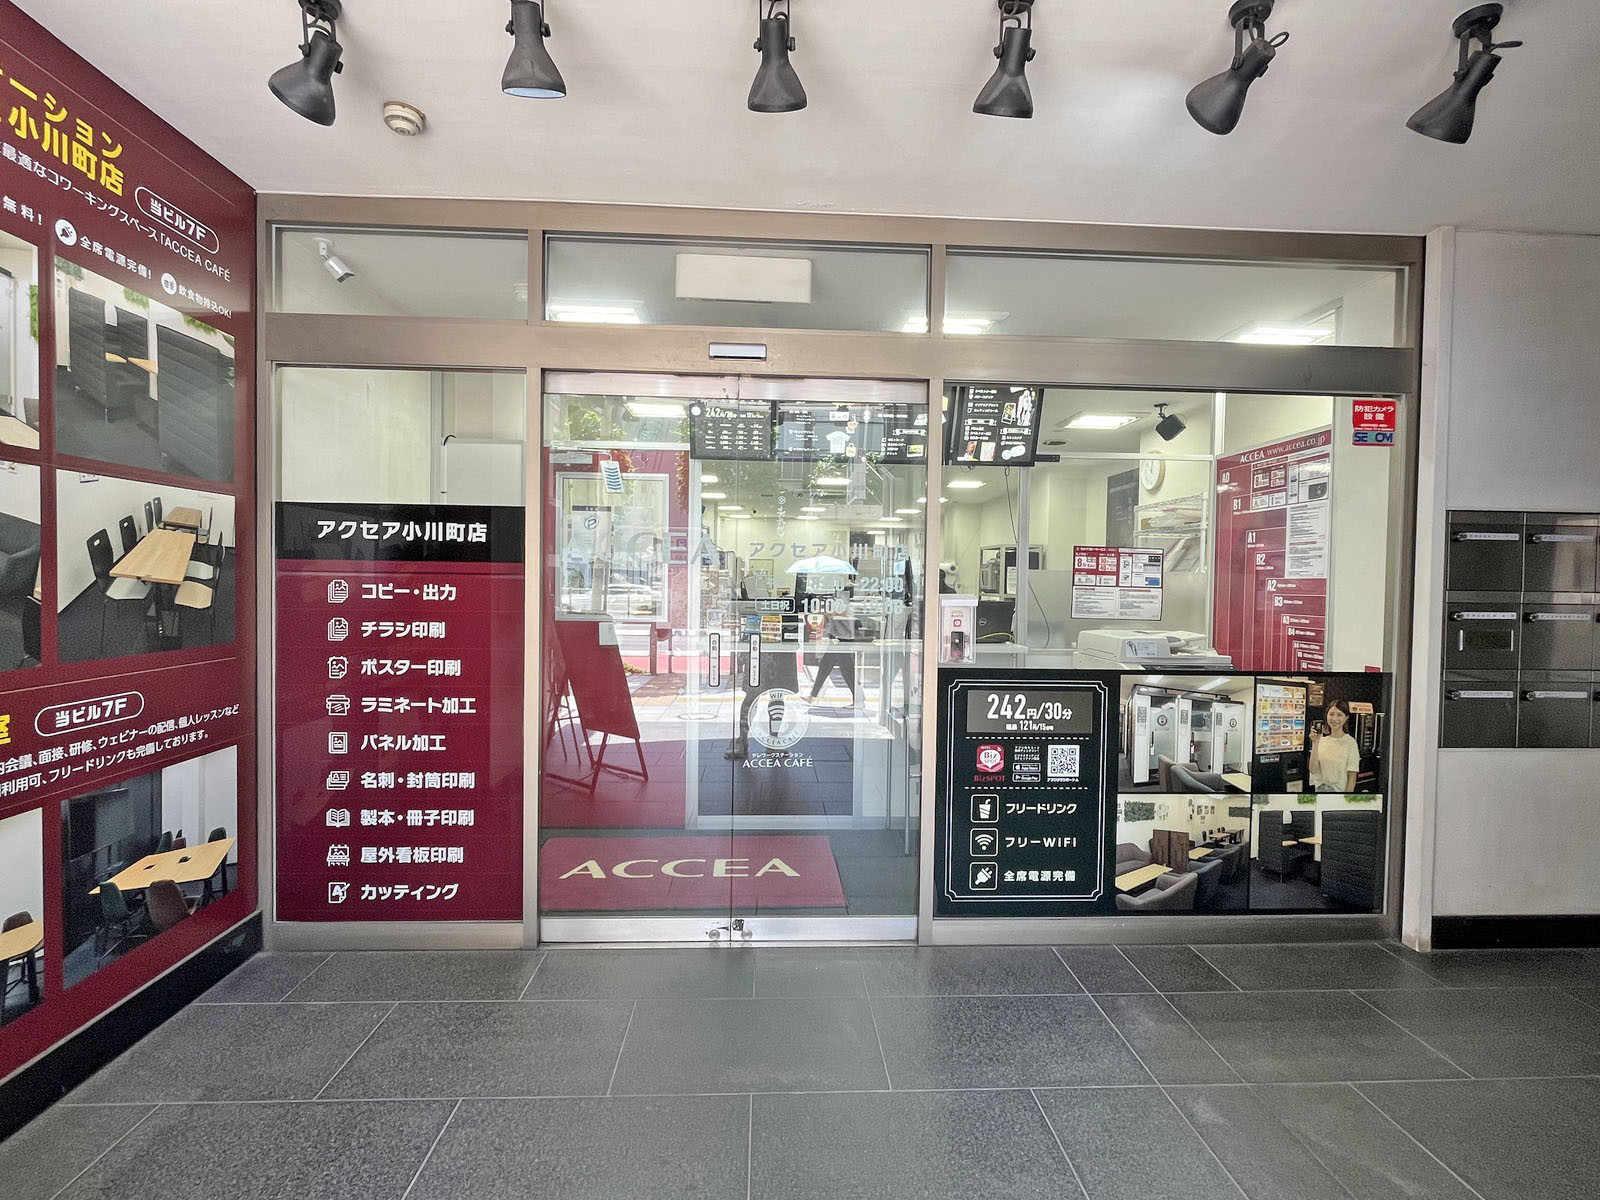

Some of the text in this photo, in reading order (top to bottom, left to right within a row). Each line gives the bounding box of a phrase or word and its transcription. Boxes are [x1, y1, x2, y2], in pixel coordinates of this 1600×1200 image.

[0, 67, 123, 159] ーション
[8, 105, 124, 197] 小川町店
[0, 141, 231, 283] 最適なコワーキングスペース「ACCEA CAFÉ
[149, 197, 207, 241] 当ビル7F
[1354, 404, 1394, 413] 防犯カメラ
[1354, 431, 1393, 443] SECOM
[1239, 434, 1325, 464] ACCEA www.accea.co.jp
[1233, 498, 1241, 511] B1
[316, 520, 488, 543] アクセア小川町店
[1247, 531, 1256, 544] A1
[1256, 553, 1266, 566] B2
[361, 583, 457, 601] コピー・出力
[1267, 579, 1277, 592] A2
[760, 599, 790, 611] 土日祝
[1274, 596, 1283, 607] B3
[361, 621, 446, 639] チラシ印刷
[361, 659, 461, 677] ポスター印刷
[55, 697, 128, 729] 当ビル7F
[361, 697, 476, 714] ラミネート加工
[987, 693, 1073, 720] 242円/30分
[361, 734, 447, 752] パネル加工
[0, 729, 209, 799] 利用可、フリードリンクも完備しております。
[742, 755, 813, 768] ACCEA CAFÉ
[360, 772, 476, 789] 名刺・封筒印刷
[1005, 802, 1077, 815] フリードリンク
[360, 809, 475, 827] 製本・冊子印刷
[360, 846, 464, 864] 屋外看板印刷
[559, 857, 801, 879] ACCEA
[1003, 869, 1076, 882] 全席電源完備
[360, 883, 460, 901] カッティング
